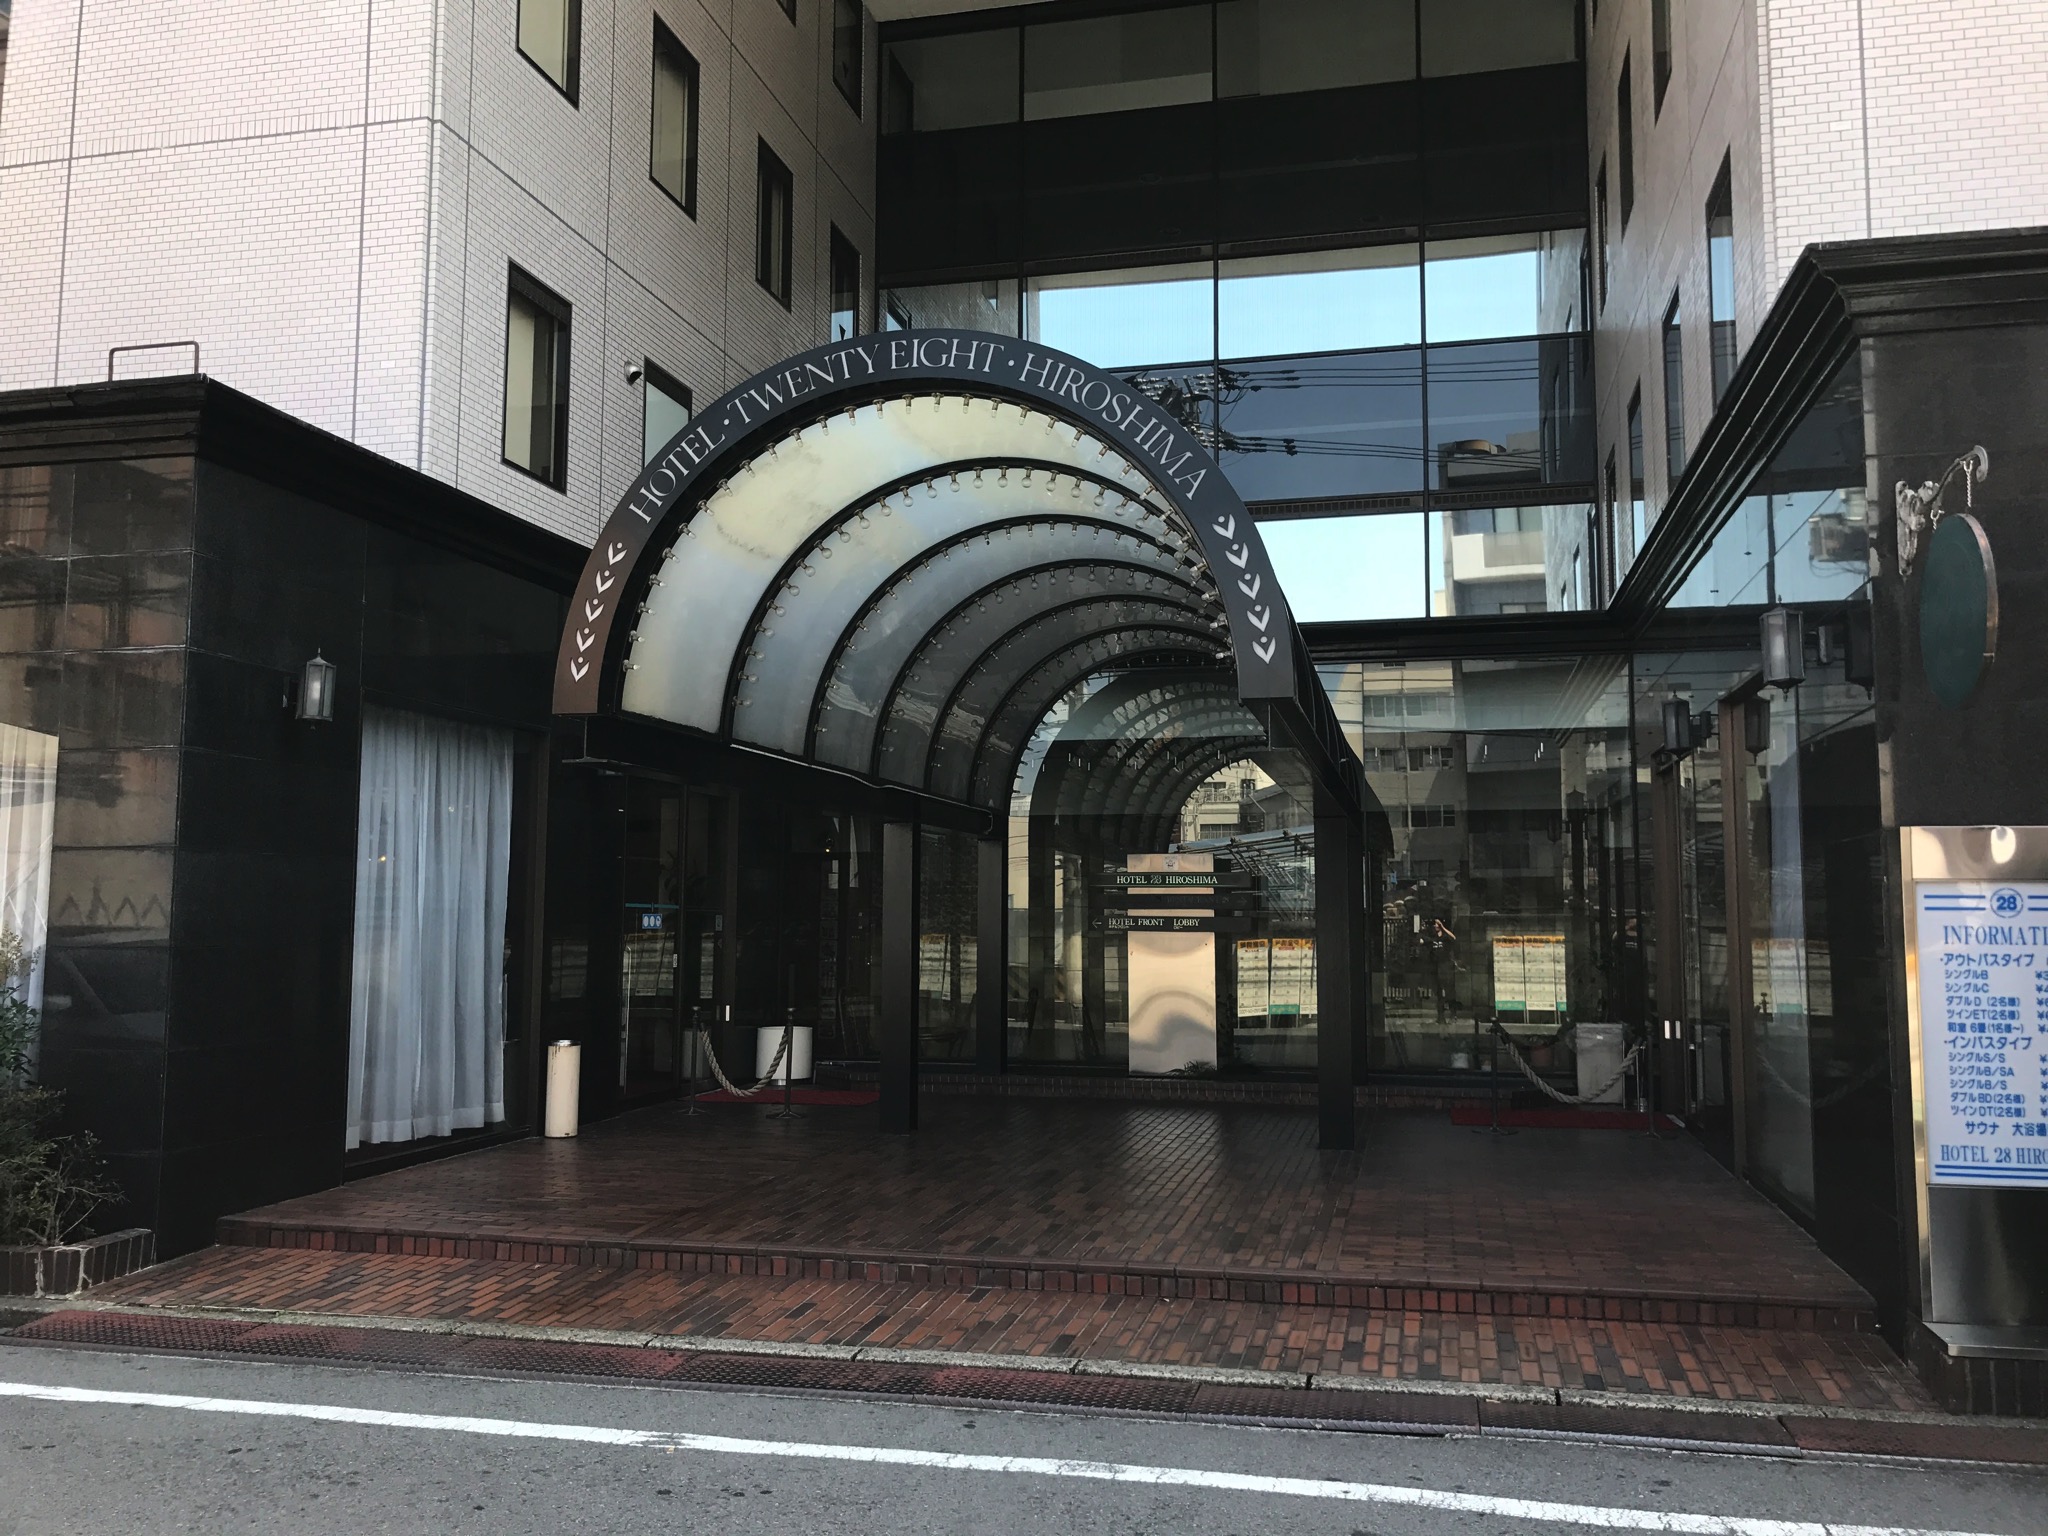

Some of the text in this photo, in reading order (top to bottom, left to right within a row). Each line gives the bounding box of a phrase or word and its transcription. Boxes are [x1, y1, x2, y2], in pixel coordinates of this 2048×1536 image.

[628, 337, 1208, 524] HOTEL TWENTY EIGHT HIROSHIMA
[1116, 875, 1148, 884] HOTEL
[1165, 875, 1218, 884] HIROSHIMA
[1996, 895, 2018, 911] 28
[1108, 917, 1200, 926] HOTEL FRONT LOBBY
[1944, 982, 1990, 993] シングルC
[1965, 1121, 1999, 1135] サウナ
[1940, 1144, 1989, 1162] HOTEL
[1994, 1147, 2012, 1163] 28
